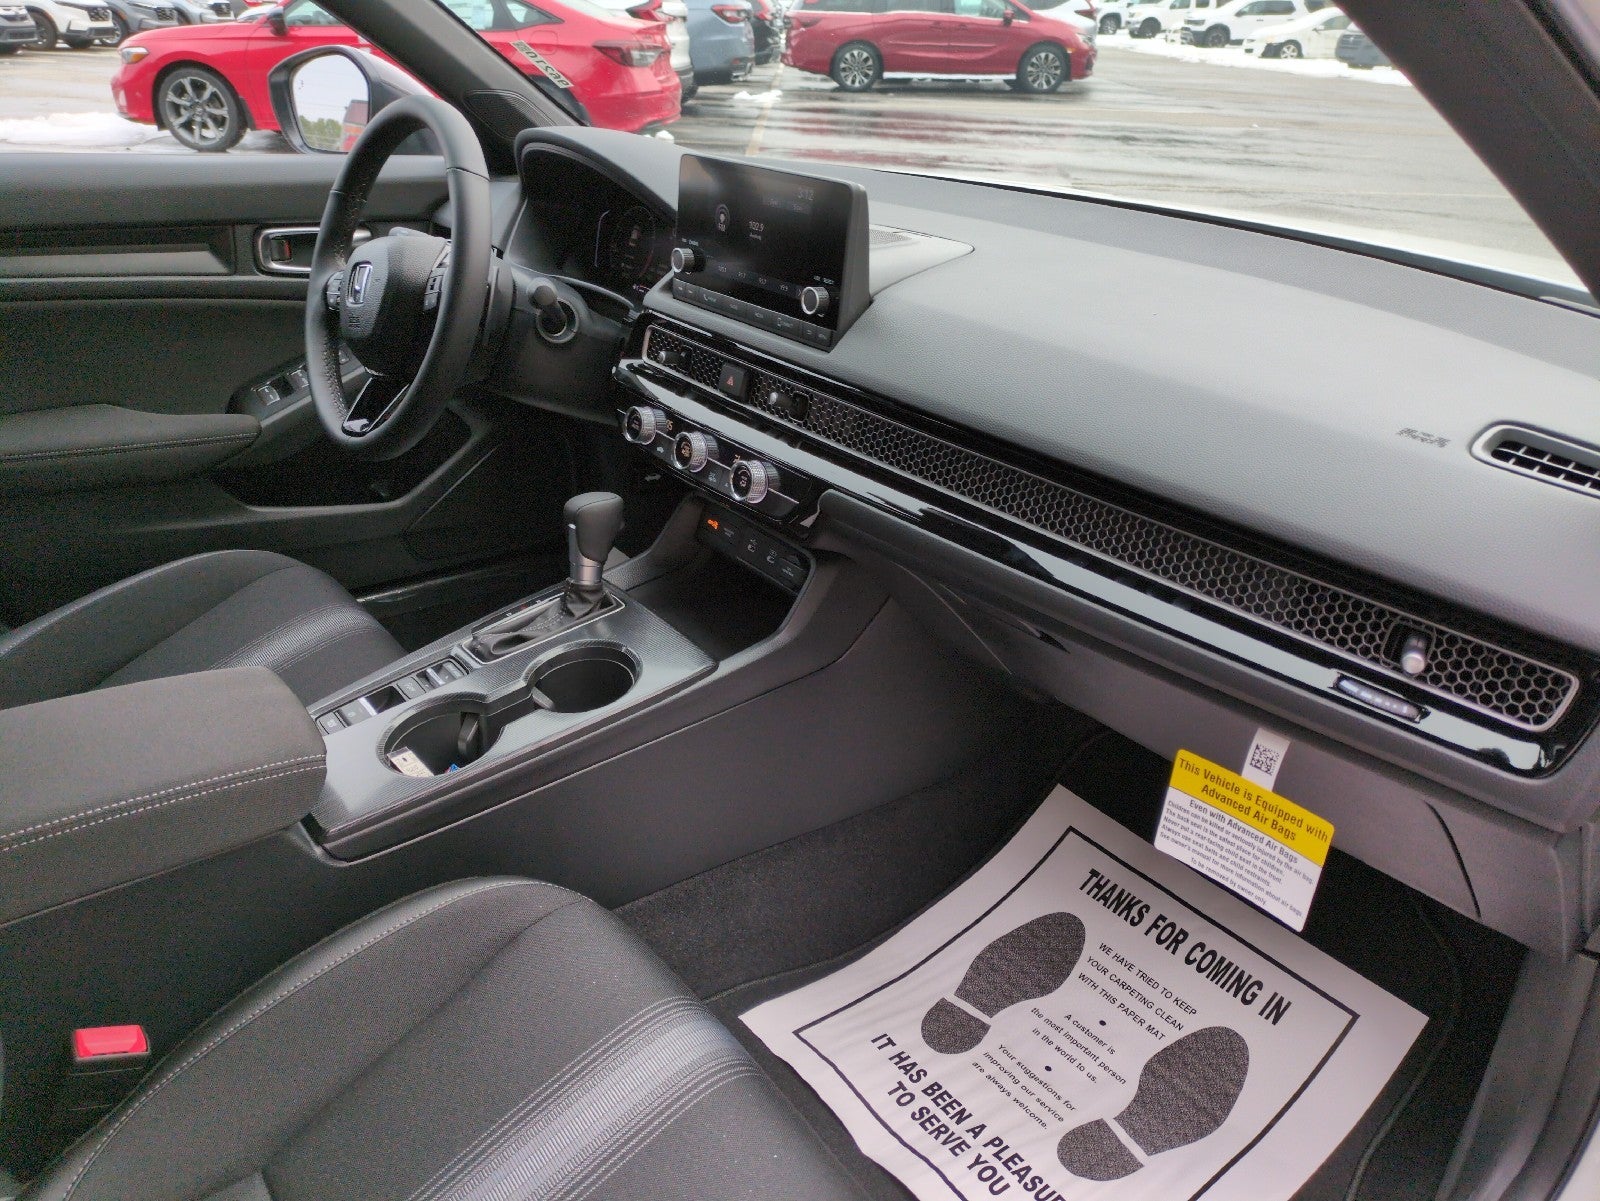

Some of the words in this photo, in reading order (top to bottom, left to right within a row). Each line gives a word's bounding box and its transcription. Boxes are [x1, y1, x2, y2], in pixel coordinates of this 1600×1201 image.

[1178, 758, 1201, 776] This
[1203, 769, 1241, 795] Vehicle
[1243, 789, 1253, 801] is
[1254, 795, 1304, 830] Equipped
[1305, 823, 1329, 843] with
[1189, 799, 1208, 815] Even
[1209, 810, 1226, 824] with
[1227, 819, 1264, 844] Advanced
[1266, 840, 1278, 852] Air
[1279, 848, 1299, 865] Bags
[1202, 784, 1251, 817] Advanced
[1253, 810, 1269, 825] Air
[1270, 820, 1297, 843] Bags
[1079, 868, 1150, 927] THANKS
[1144, 914, 1189, 955] FOR
[1184, 942, 1263, 1005] COMING
[1258, 992, 1292, 1026] IN
[1099, 943, 1112, 956] WE
[1112, 952, 1136, 972] HAVE
[1136, 969, 1160, 990] TRIED
[1161, 987, 1173, 999] TO
[1173, 998, 1197, 1016] KEEP
[1078, 972, 1099, 990] WITH
[1099, 989, 1118, 1005] THIS
[1117, 1003, 1145, 1026] PAPER
[1146, 1025, 1166, 1041] MAT
[1087, 956, 1108, 976] YOUR
[1109, 974, 1154, 1010] CARPETING
[1155, 1008, 1184, 1031] CLEAN
[1031, 1007, 1043, 1019] the
[1043, 1017, 1064, 1033] most
[1063, 1030, 1099, 1063] important
[1098, 1061, 1127, 1085] person
[1032, 1027, 1040, 1037] in
[1041, 1034, 1054, 1046] the
[1054, 1044, 1075, 1064] world
[1076, 1062, 1085, 1072] to
[1086, 1071, 1098, 1084] us.
[1072, 1019, 1110, 1048] customer
[1108, 1045, 1116, 1055] is
[871, 1034, 896, 1050] IT
[888, 1051, 927, 1084] HAS
[921, 1082, 973, 1126] BEEN
[966, 1123, 987, 1140] A
[972, 1061, 986, 1074] are
[985, 1073, 1011, 1098] always
[1013, 1098, 1048, 1130] welcome.
[983, 1051, 1021, 1086] improving
[1021, 1085, 1036, 1098] our
[1036, 1097, 1064, 1123] service
[999, 1044, 1016, 1063] Your
[1016, 1060, 1062, 1102] suggestions
[1063, 1099, 1077, 1112] for
[887, 1081, 916, 1107] TO
[910, 1106, 972, 1157] SERVE
[967, 1153, 1011, 1196] YOU
